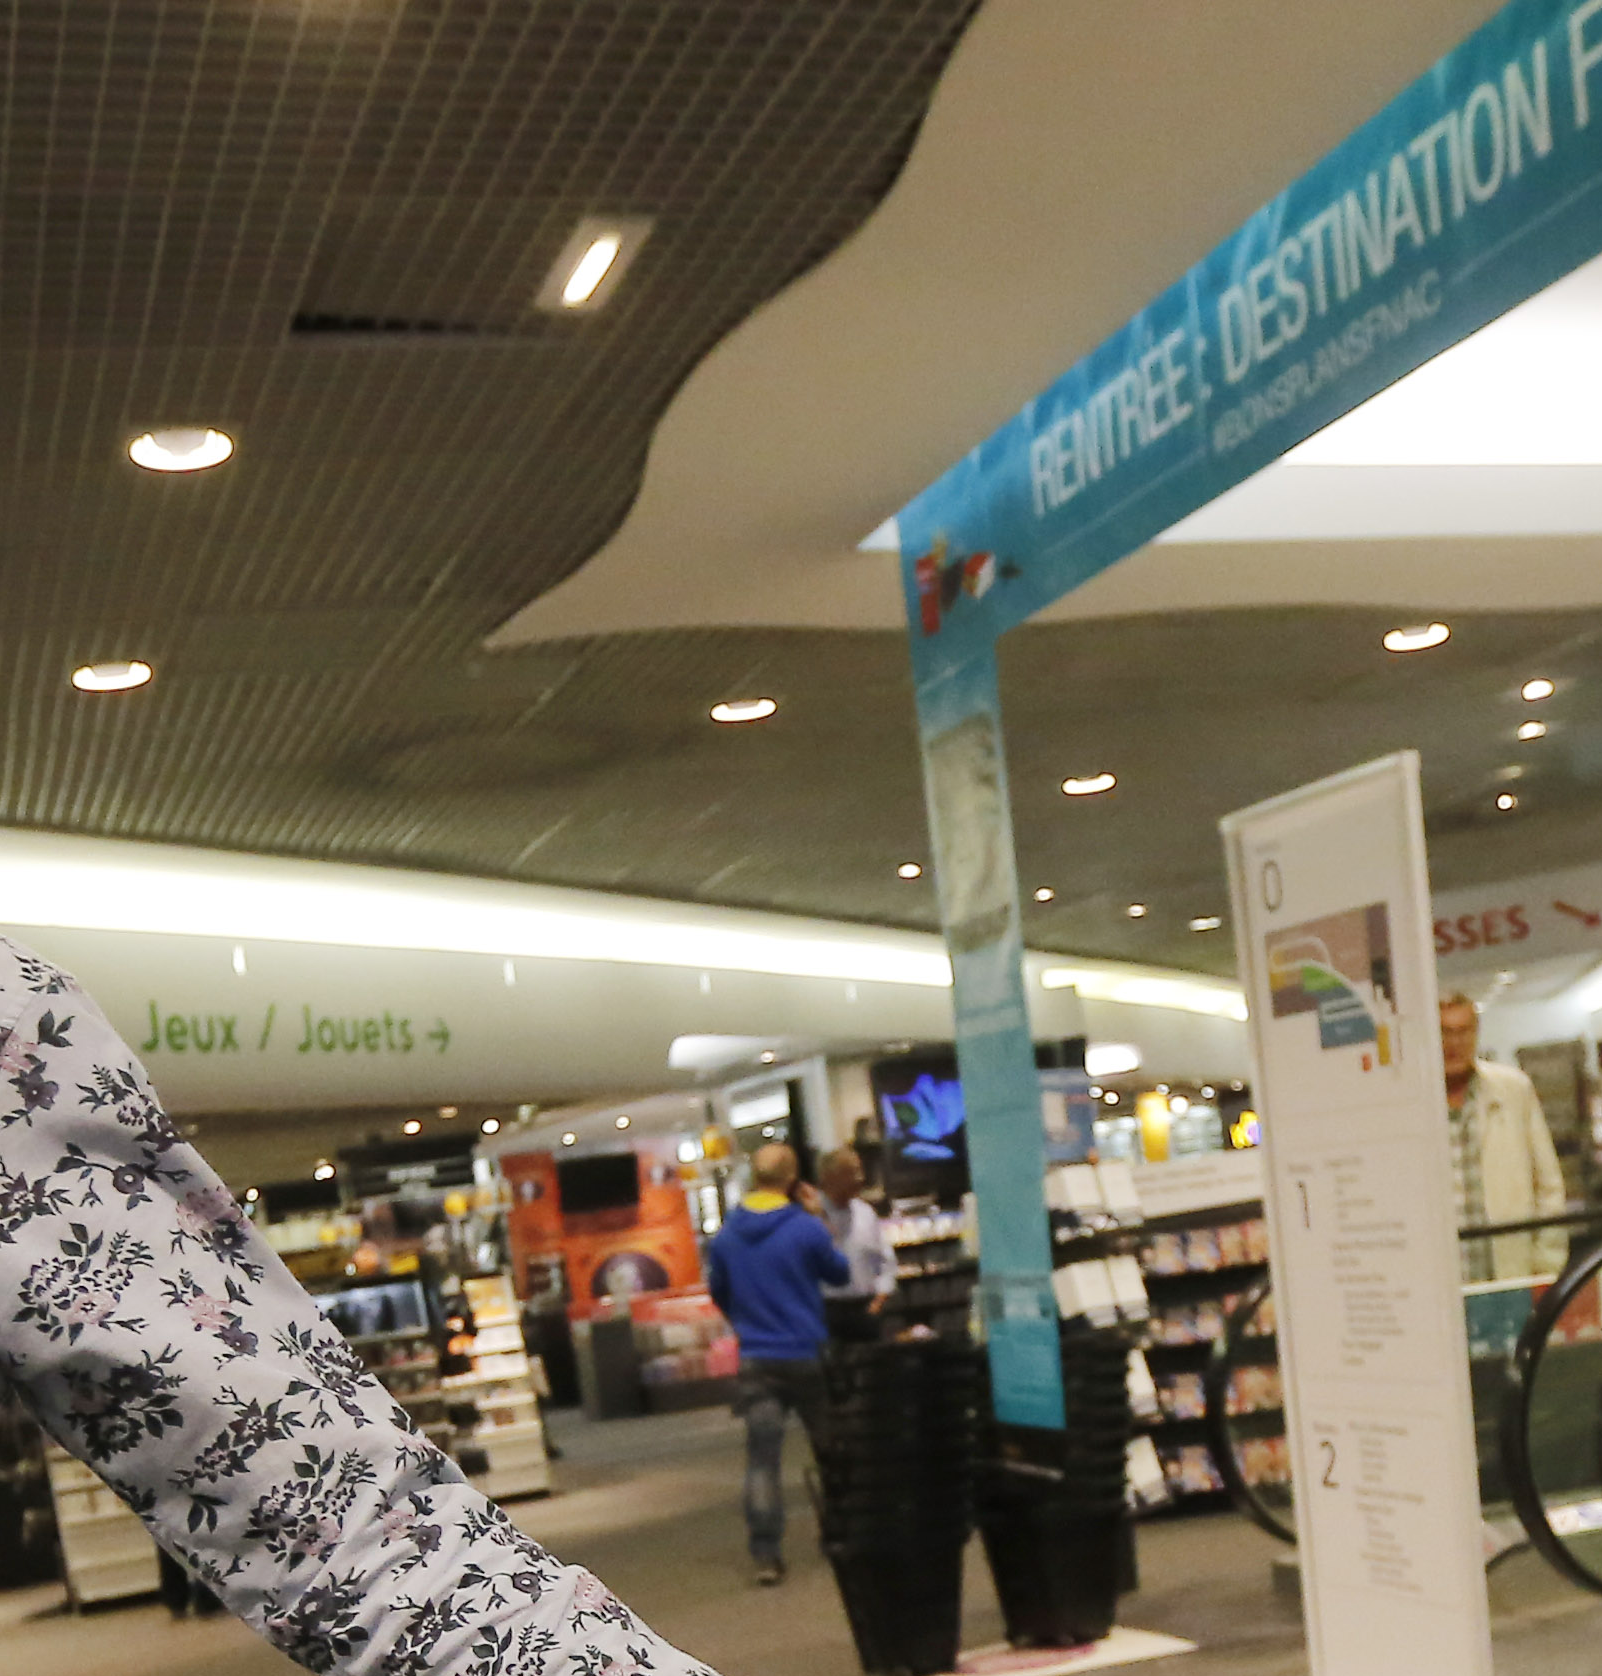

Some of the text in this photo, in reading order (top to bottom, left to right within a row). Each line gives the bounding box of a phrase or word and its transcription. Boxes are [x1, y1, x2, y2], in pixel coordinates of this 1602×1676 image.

[1217, 38, 1554, 385] DESTINATION
[140, 1000, 240, 1054] Jeux
[297, 1002, 414, 1055] Jouets
